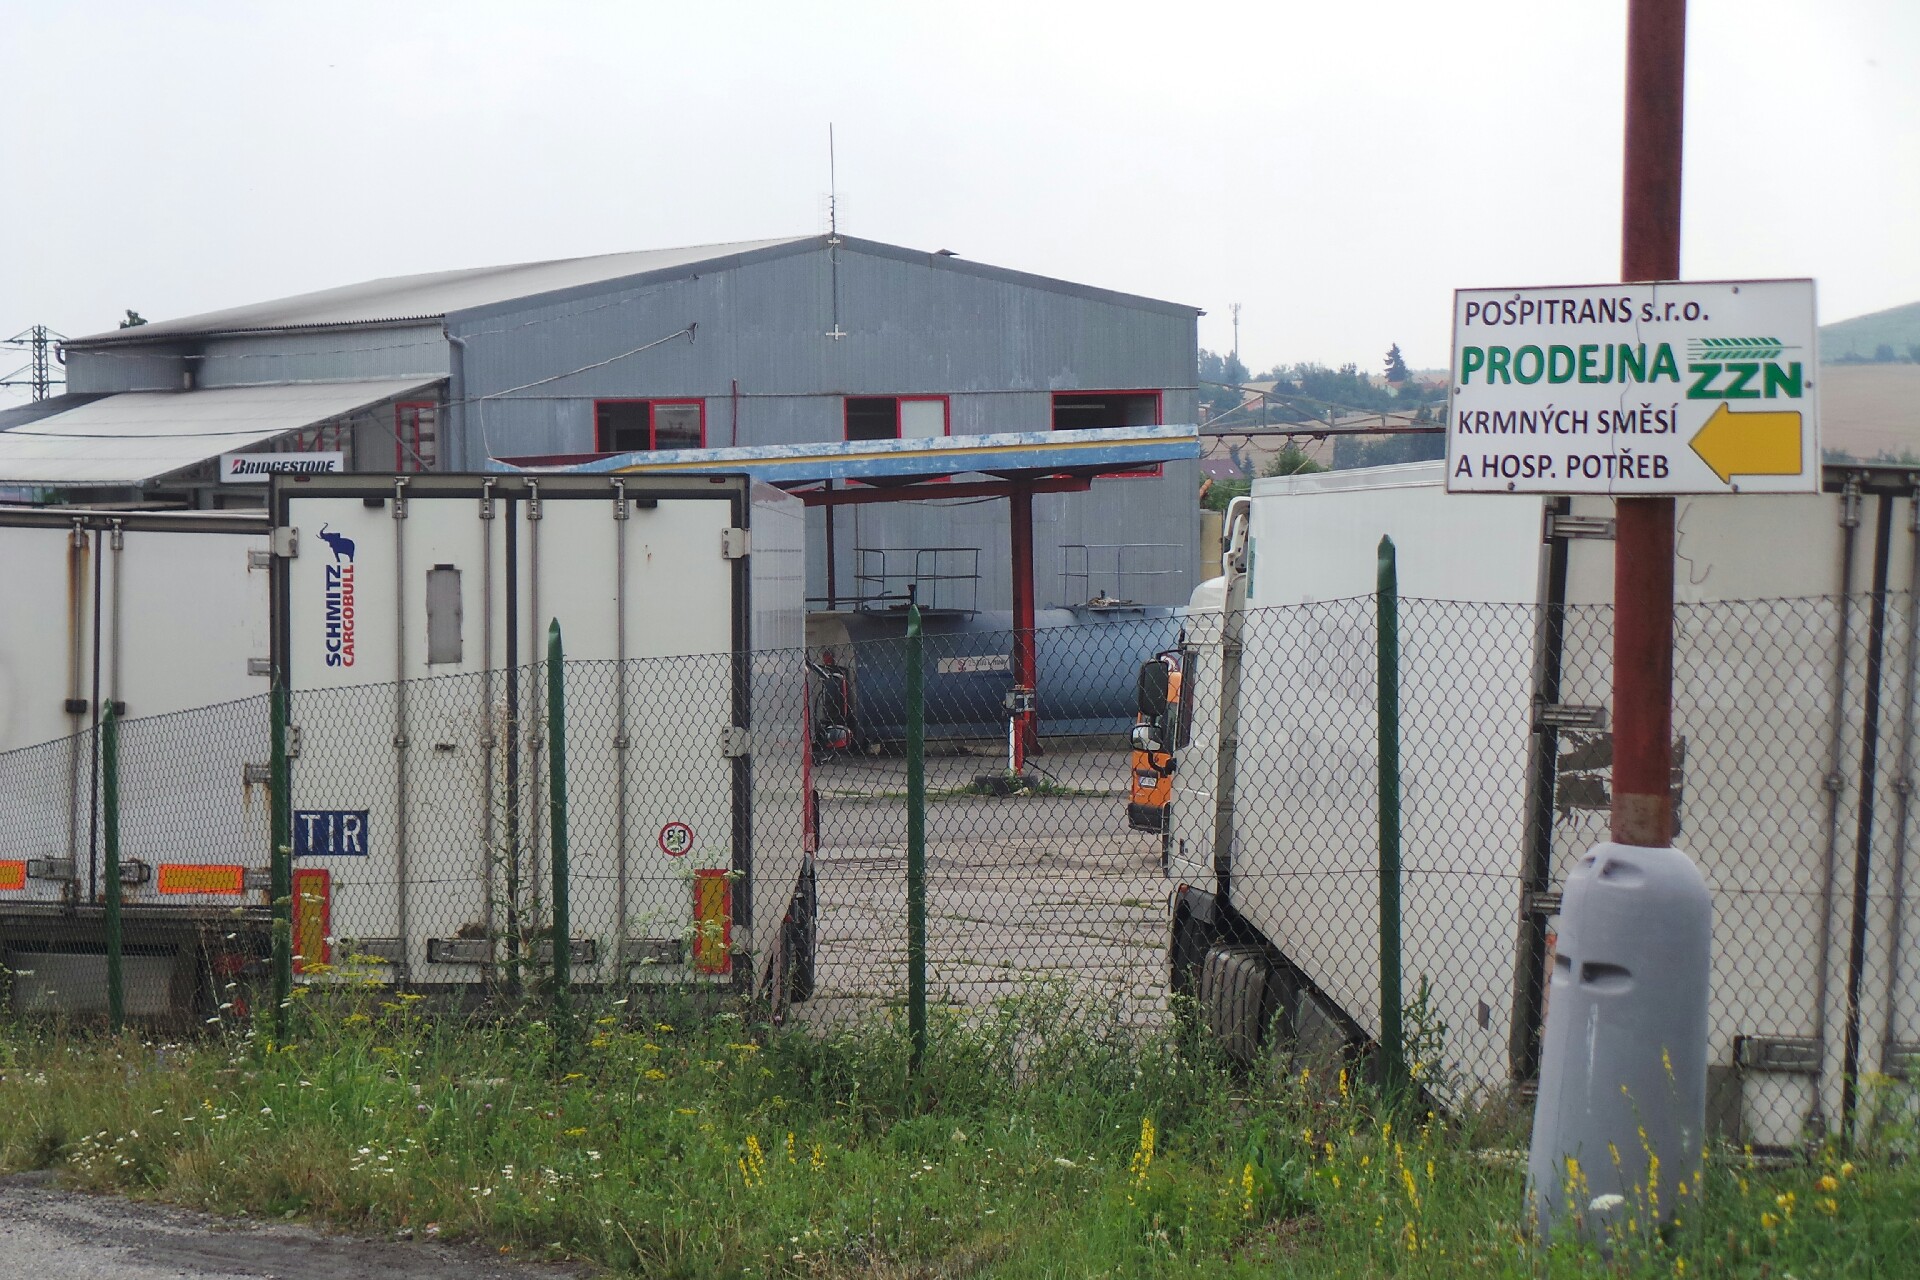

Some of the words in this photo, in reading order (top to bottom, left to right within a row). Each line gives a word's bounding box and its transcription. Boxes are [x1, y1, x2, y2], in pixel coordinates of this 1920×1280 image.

[1465, 297, 1632, 326] POSPITRANS
[1641, 300, 1709, 323] s.r.o.
[1460, 342, 1681, 385] PRODEJNA
[1686, 361, 1803, 400] ZZN
[1458, 404, 1588, 434] KRMNÝCH
[1597, 402, 1679, 434] SMĚSÍ
[231, 459, 335, 474] BRIDGESTONE
[1455, 454, 1473, 478] A
[1482, 454, 1556, 479] HOSP.
[1566, 448, 1669, 479] POTŘEB
[326, 564, 341, 667] SCHMITZ
[343, 564, 355, 667] CARGOBULL
[300, 814, 361, 852] TIR
